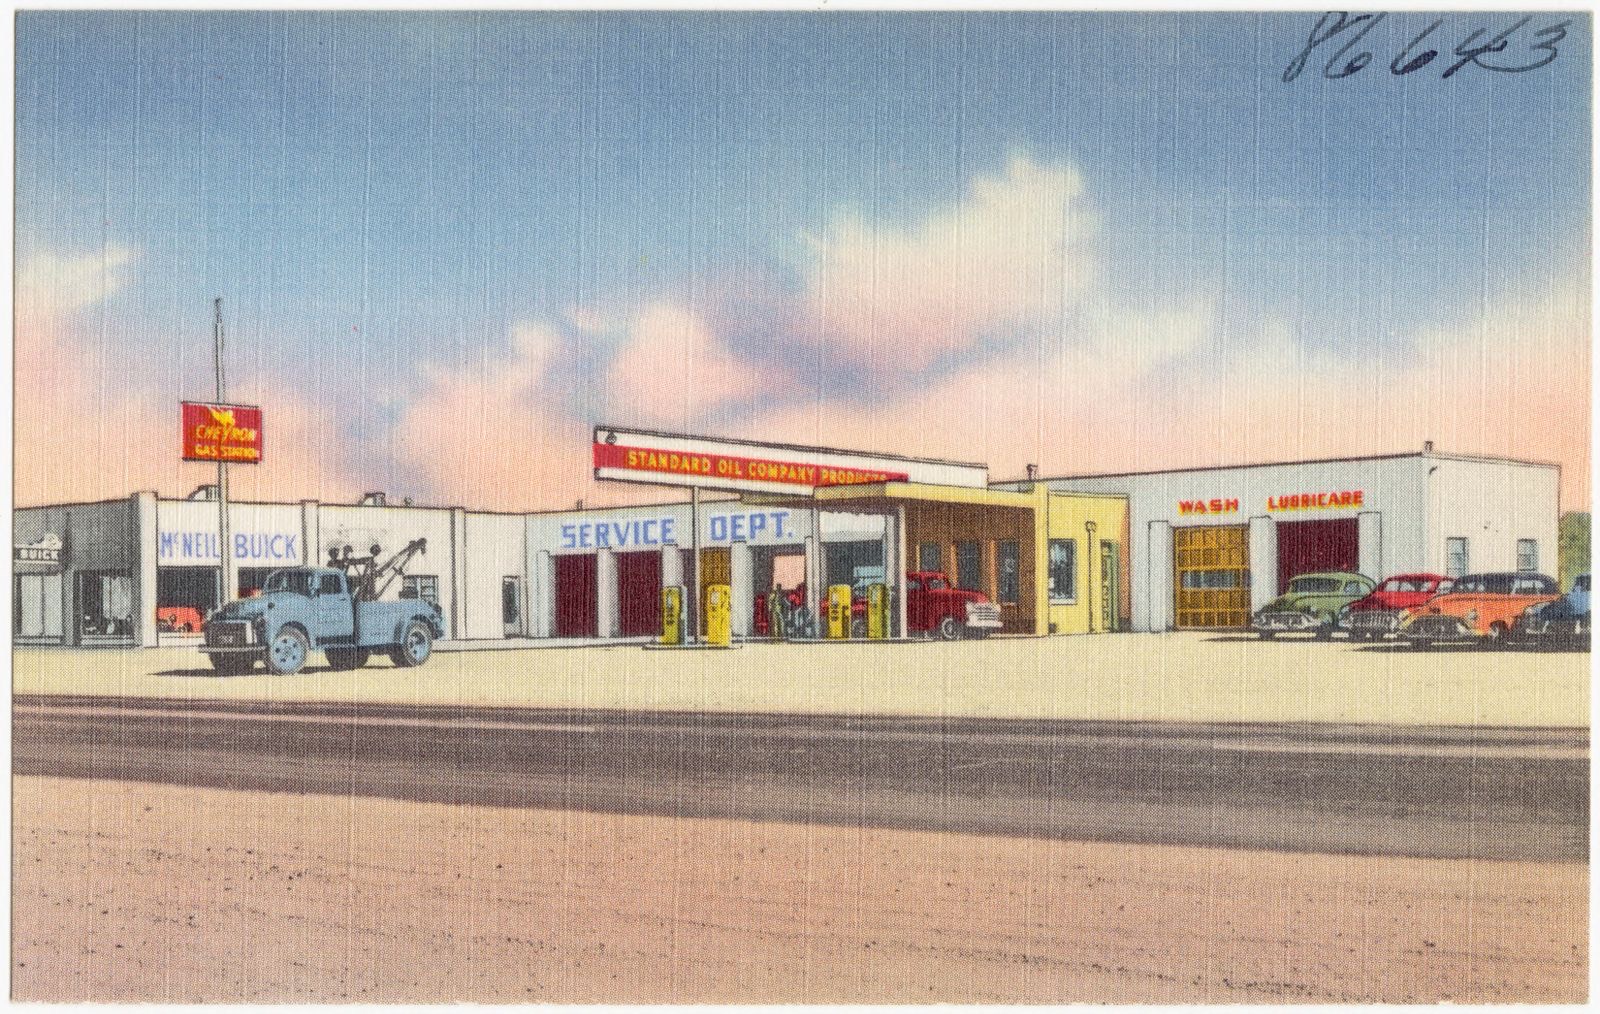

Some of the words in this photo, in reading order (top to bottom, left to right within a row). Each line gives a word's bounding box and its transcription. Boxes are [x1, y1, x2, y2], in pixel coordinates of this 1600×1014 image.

[194, 444, 218, 457] GAS
[627, 450, 712, 473] STANDARD
[717, 458, 743, 477] OIL
[747, 462, 815, 483] COMPANY
[1178, 497, 1240, 516] WASH
[1267, 490, 1365, 512] LUBRICARE
[560, 519, 676, 549] SERVICE
[710, 511, 796, 542] DEPT.
[19, 549, 59, 561] BUICK
[234, 533, 298, 560] BUICK
